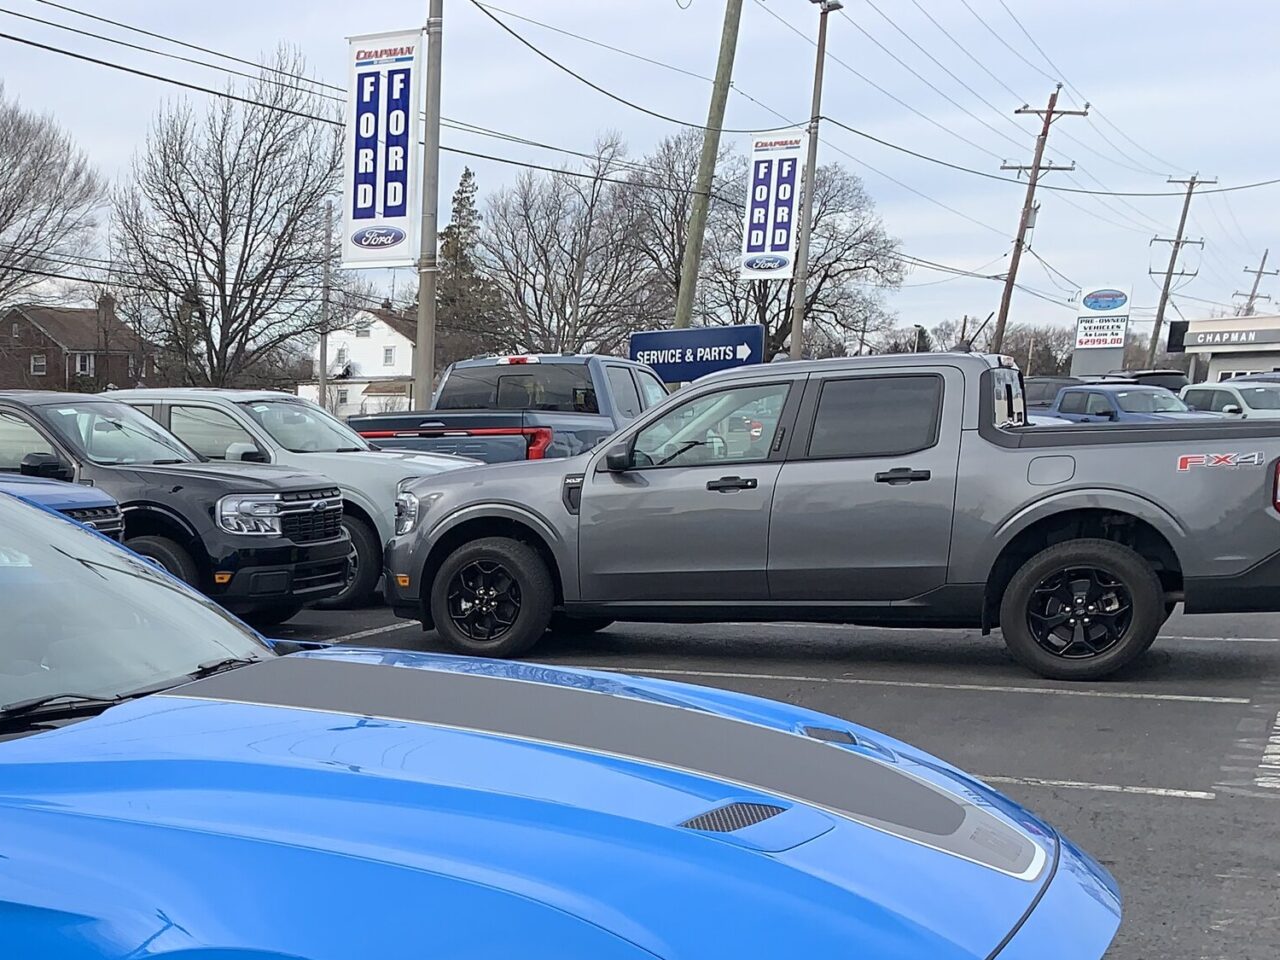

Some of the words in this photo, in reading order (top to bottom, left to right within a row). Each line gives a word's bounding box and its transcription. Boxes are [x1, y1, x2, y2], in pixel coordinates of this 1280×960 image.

[356, 46, 415, 61] CHAPMAN
[356, 76, 376, 209] FORD
[386, 73, 406, 207] FORD
[750, 162, 768, 246] FORD
[774, 160, 792, 245] FORD
[361, 228, 395, 246] Ford
[752, 256, 781, 269] Ford
[1197, 331, 1256, 343] CHAPMAN
[636, 349, 682, 364] SERVICE
[685, 348, 694, 362] &
[697, 345, 734, 361] PARTS
[1177, 451, 1265, 472] FX4
